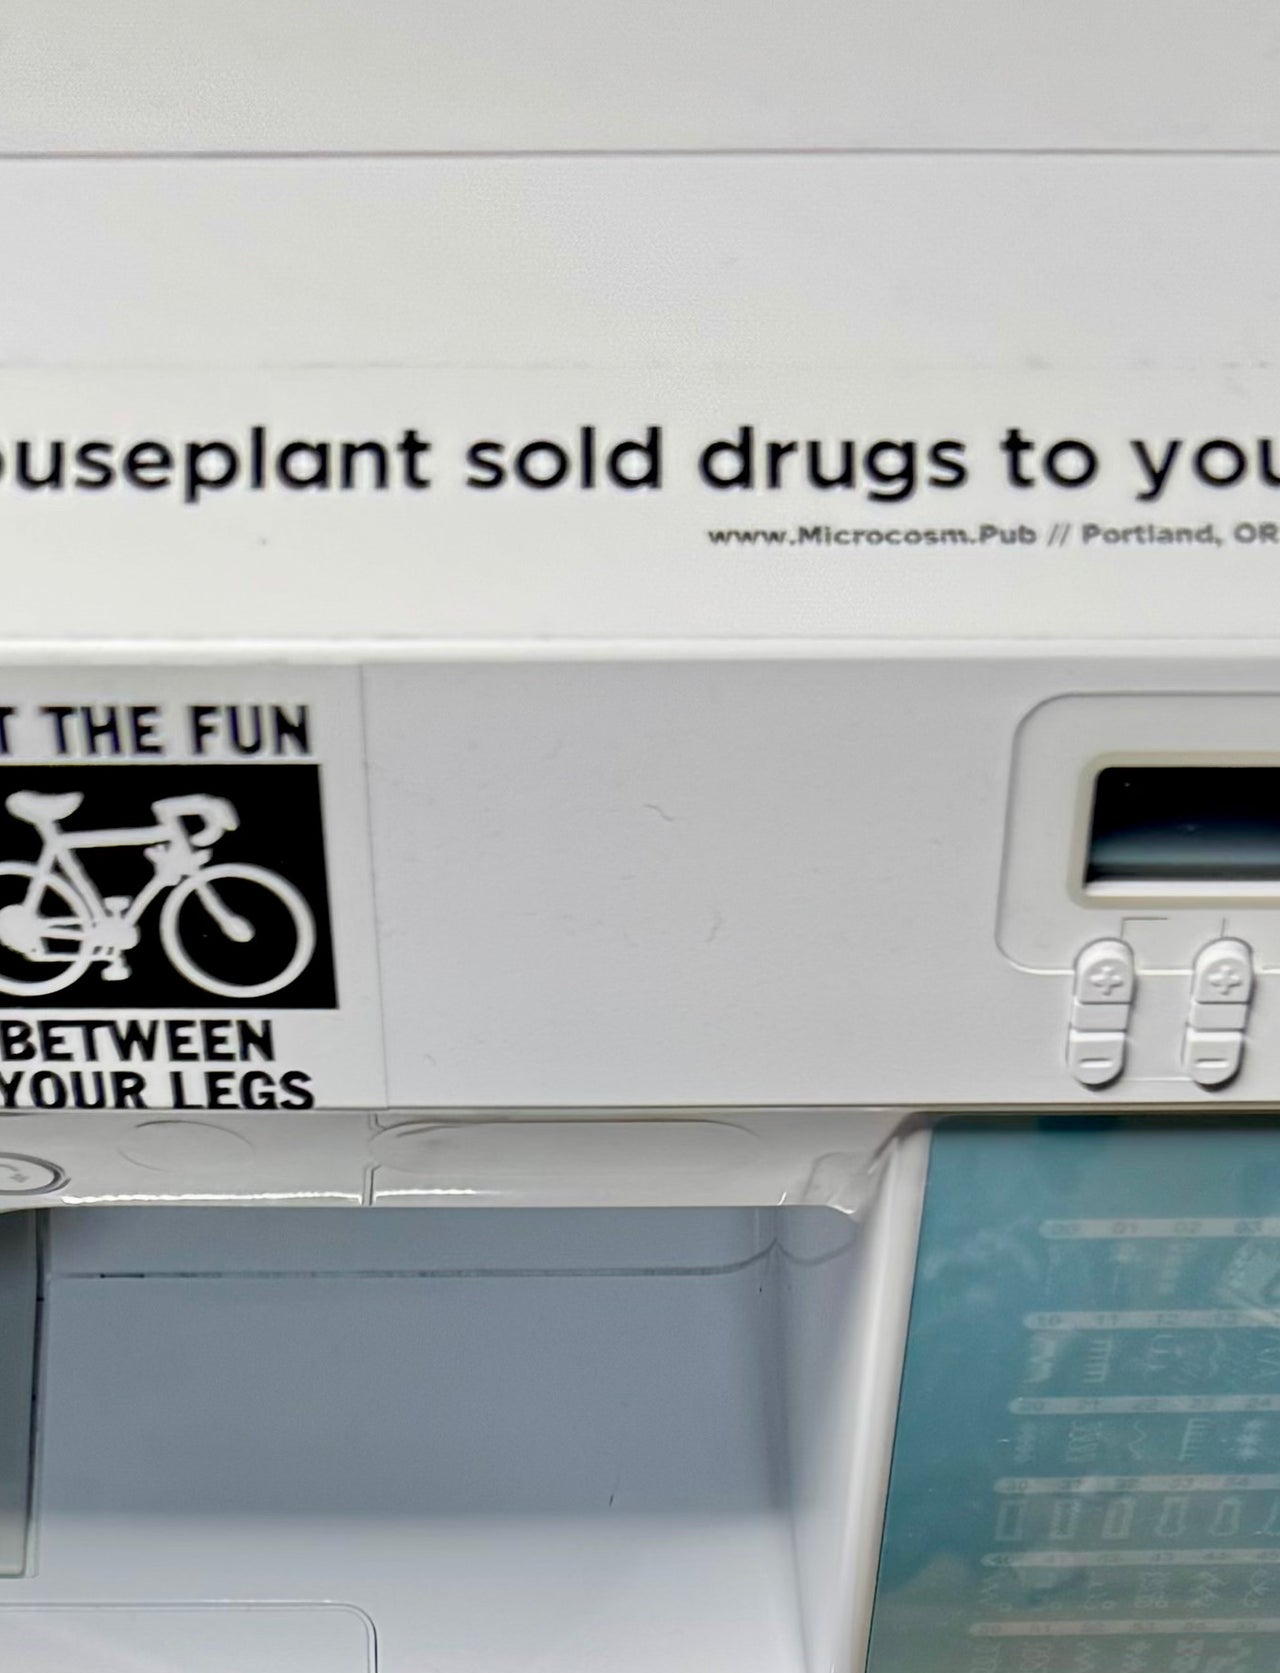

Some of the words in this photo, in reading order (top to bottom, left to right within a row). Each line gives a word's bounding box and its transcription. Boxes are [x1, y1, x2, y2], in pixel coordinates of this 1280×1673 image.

[463, 424, 663, 491] sold
[698, 424, 968, 502] drugs
[1000, 427, 1101, 489] to
[707, 523, 1037, 547] www.Microcosm.Pub
[1081, 523, 1224, 549] Portland,
[1234, 522, 1280, 546] OR
[38, 704, 163, 757] THE
[187, 703, 312, 757] FUN
[172, 1069, 316, 1111] LEGS
